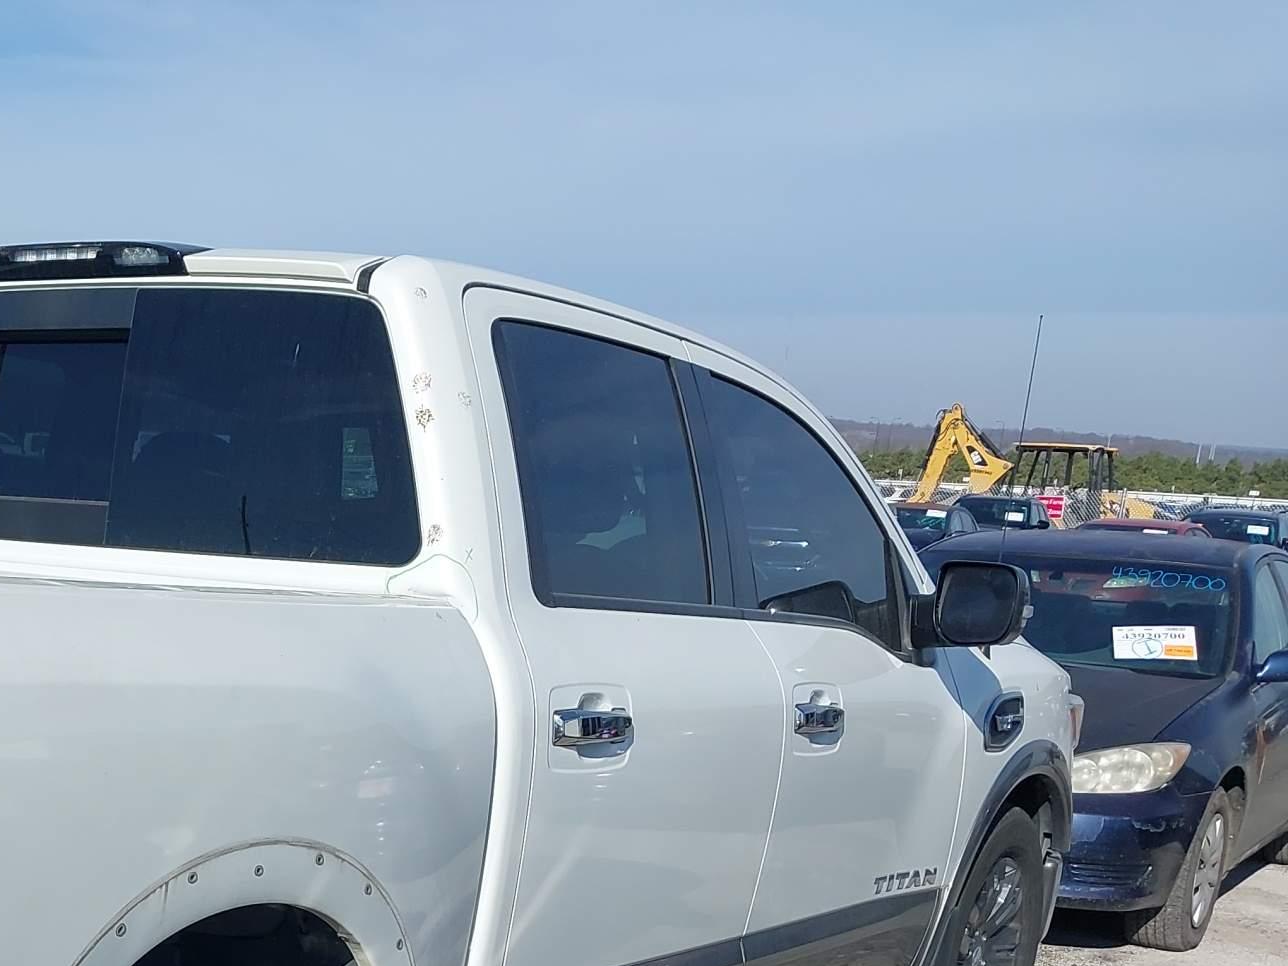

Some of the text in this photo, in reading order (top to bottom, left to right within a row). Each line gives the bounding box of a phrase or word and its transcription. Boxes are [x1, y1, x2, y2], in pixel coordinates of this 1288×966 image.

[1112, 566, 1226, 592] 43920700
[1122, 632, 1185, 640] 43920700
[873, 866, 938, 895] TITAN
